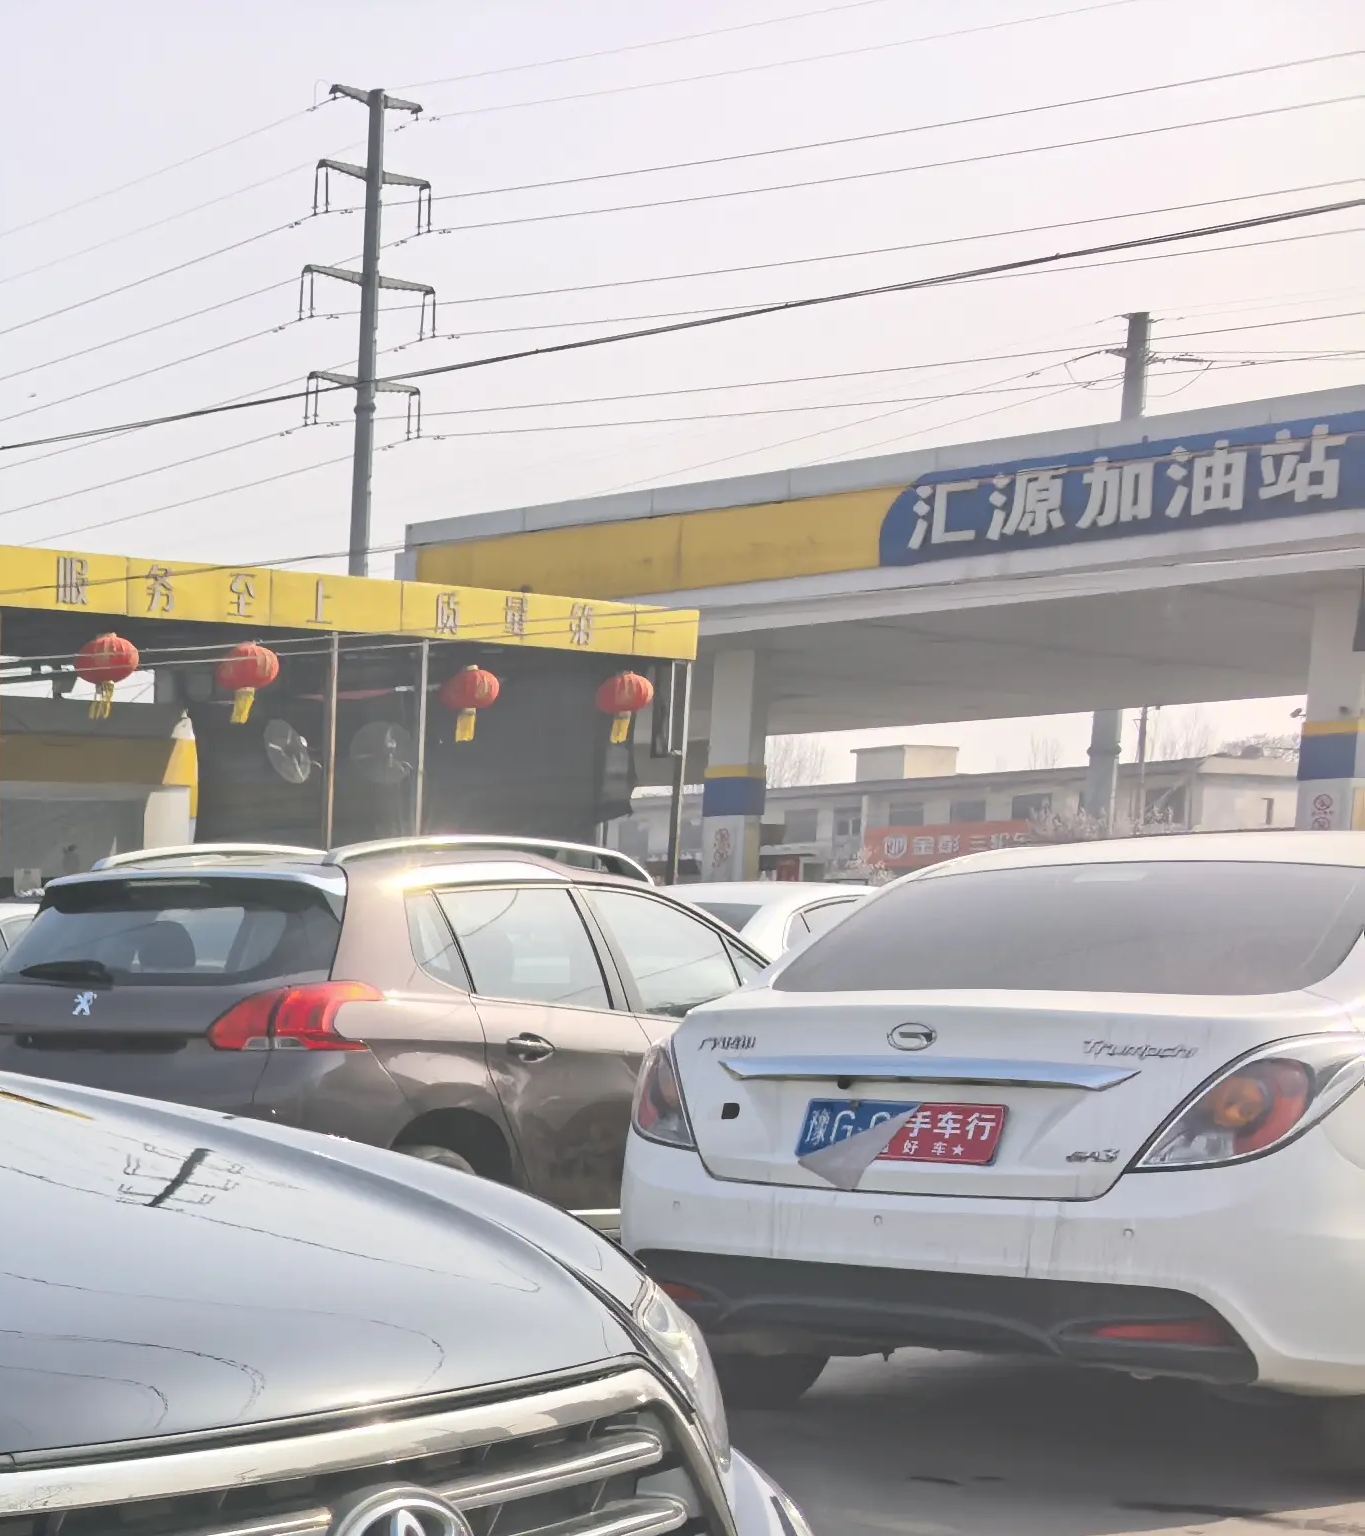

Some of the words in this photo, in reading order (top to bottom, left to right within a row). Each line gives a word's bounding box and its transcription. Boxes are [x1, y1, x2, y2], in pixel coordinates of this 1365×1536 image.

[907, 424, 1344, 550] 汇源加油站
[56, 556, 333, 625] 服务至上
